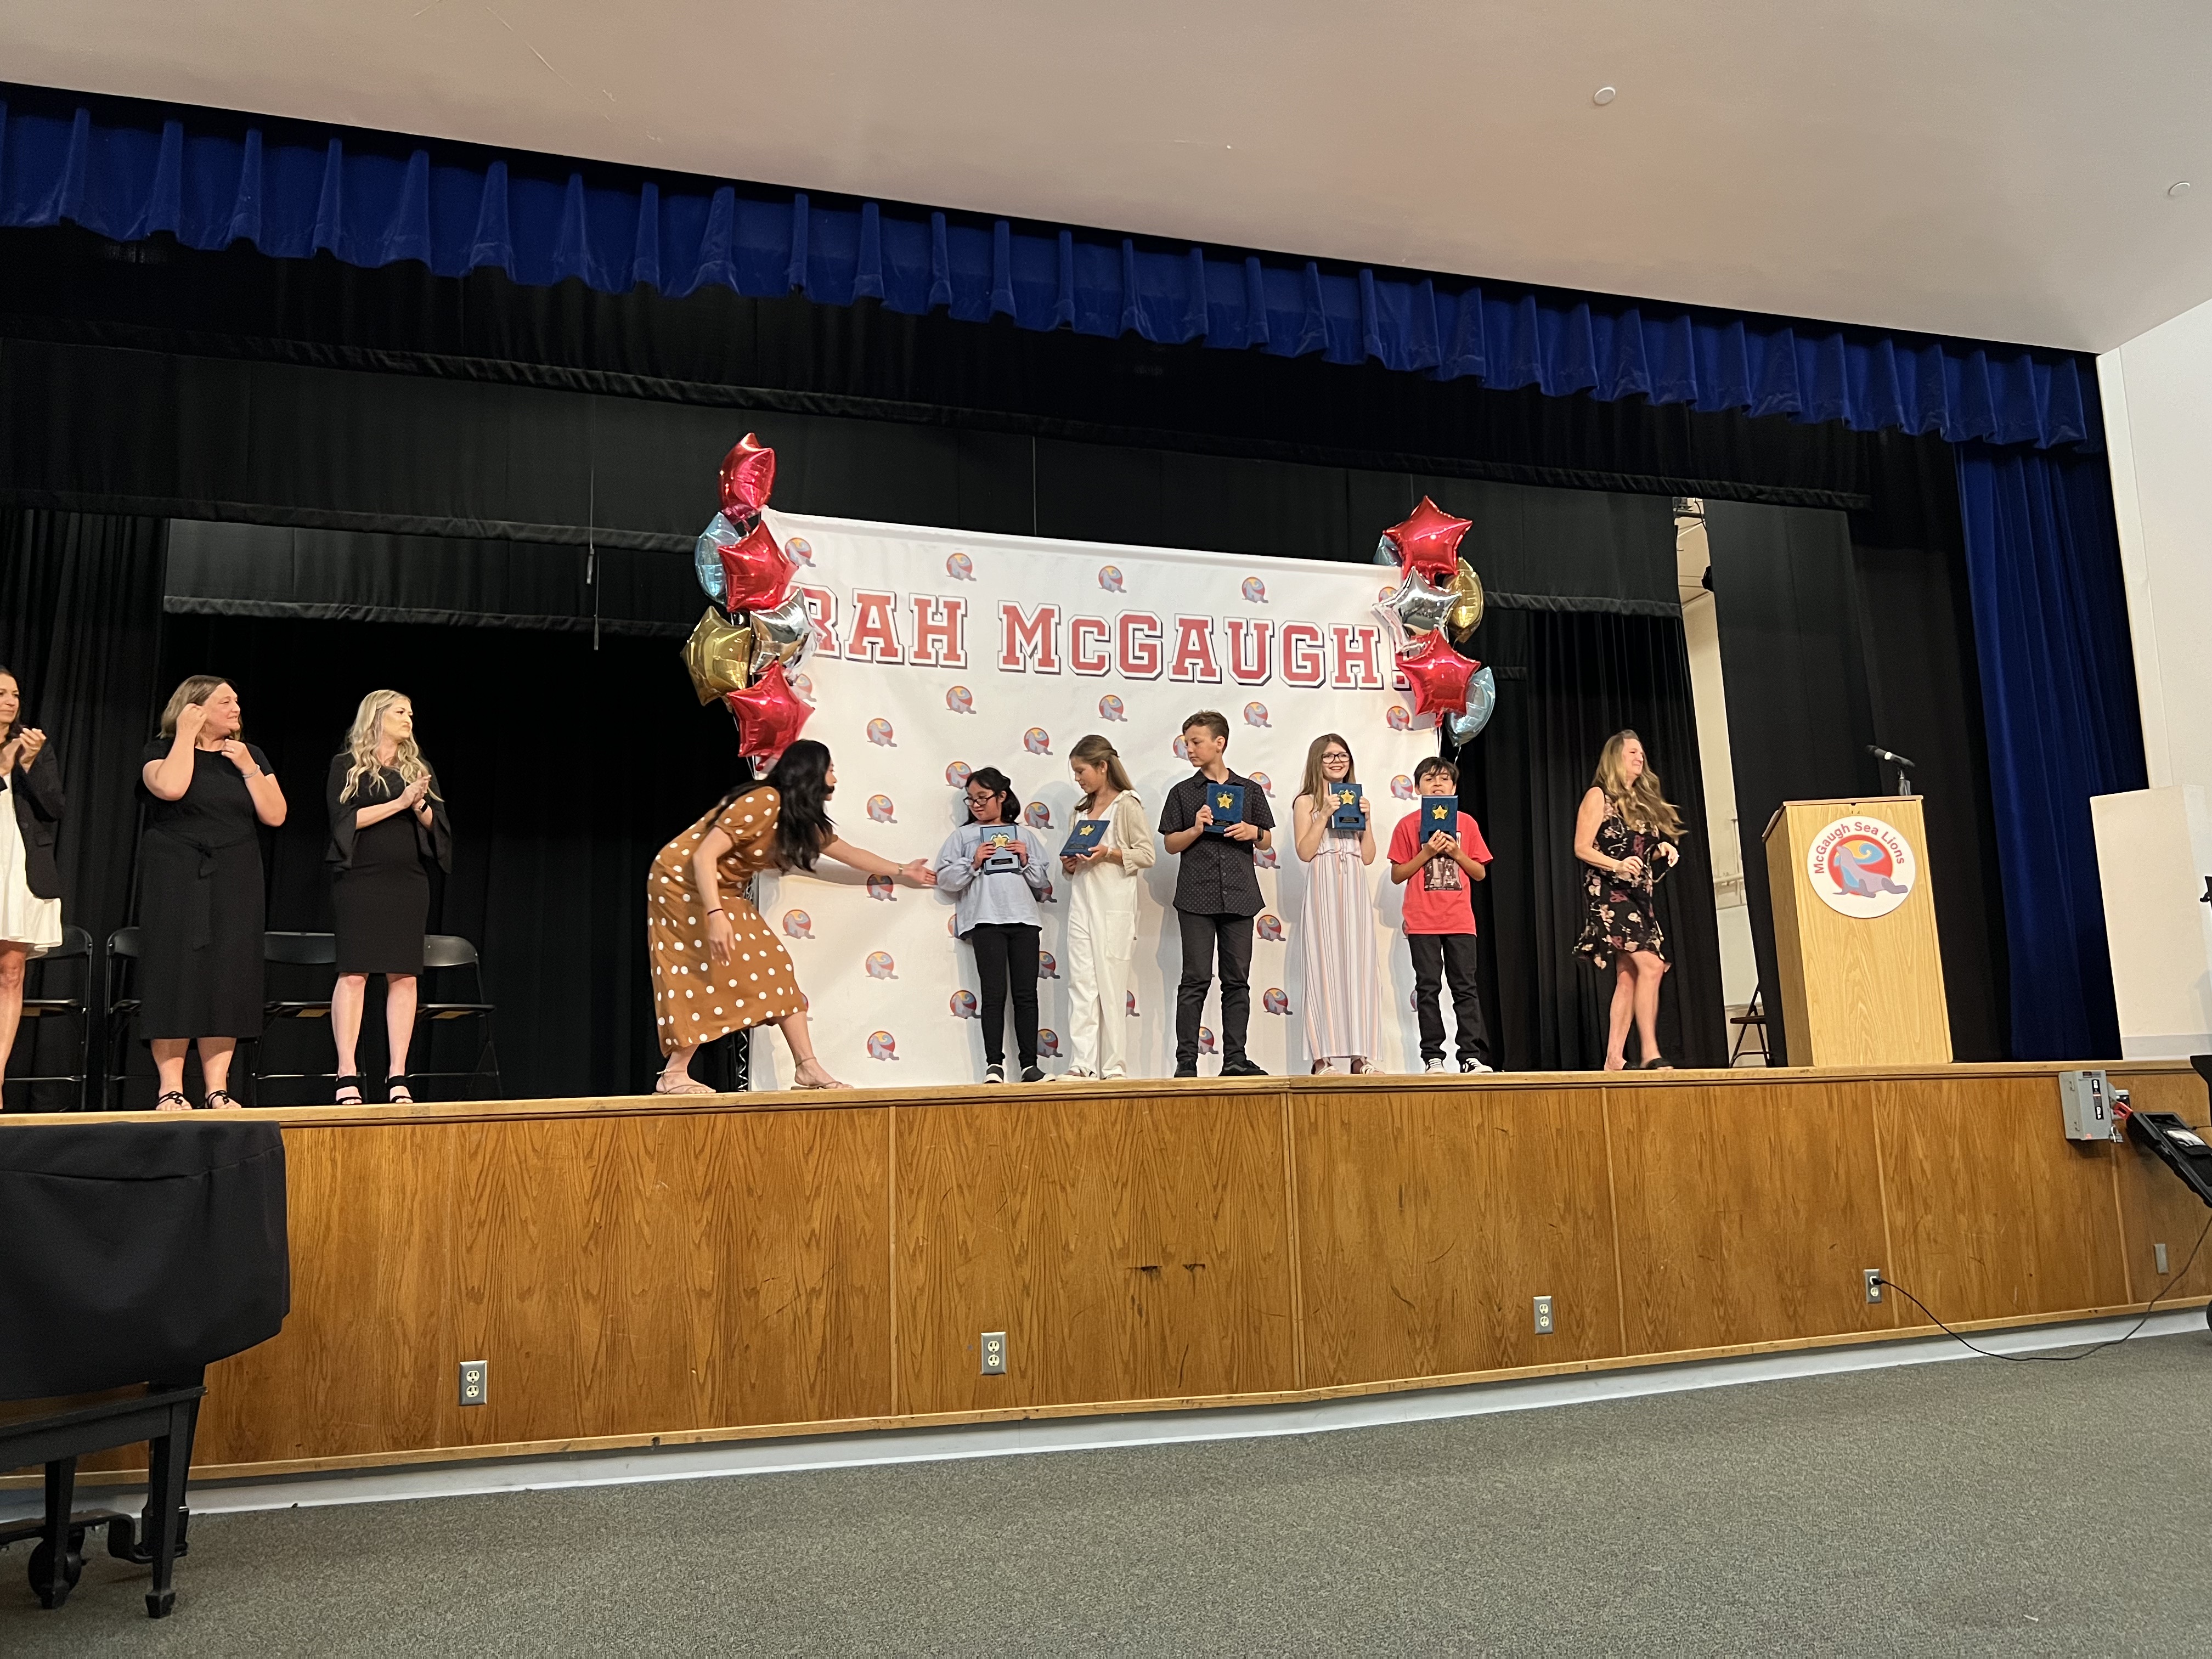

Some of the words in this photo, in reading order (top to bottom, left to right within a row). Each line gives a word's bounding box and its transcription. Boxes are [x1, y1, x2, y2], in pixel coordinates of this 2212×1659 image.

[783, 580, 968, 669] RAH
[1813, 823, 1850, 874] McGaugh
[1854, 821, 1878, 836] Sea
[1881, 831, 1905, 864] Lions
